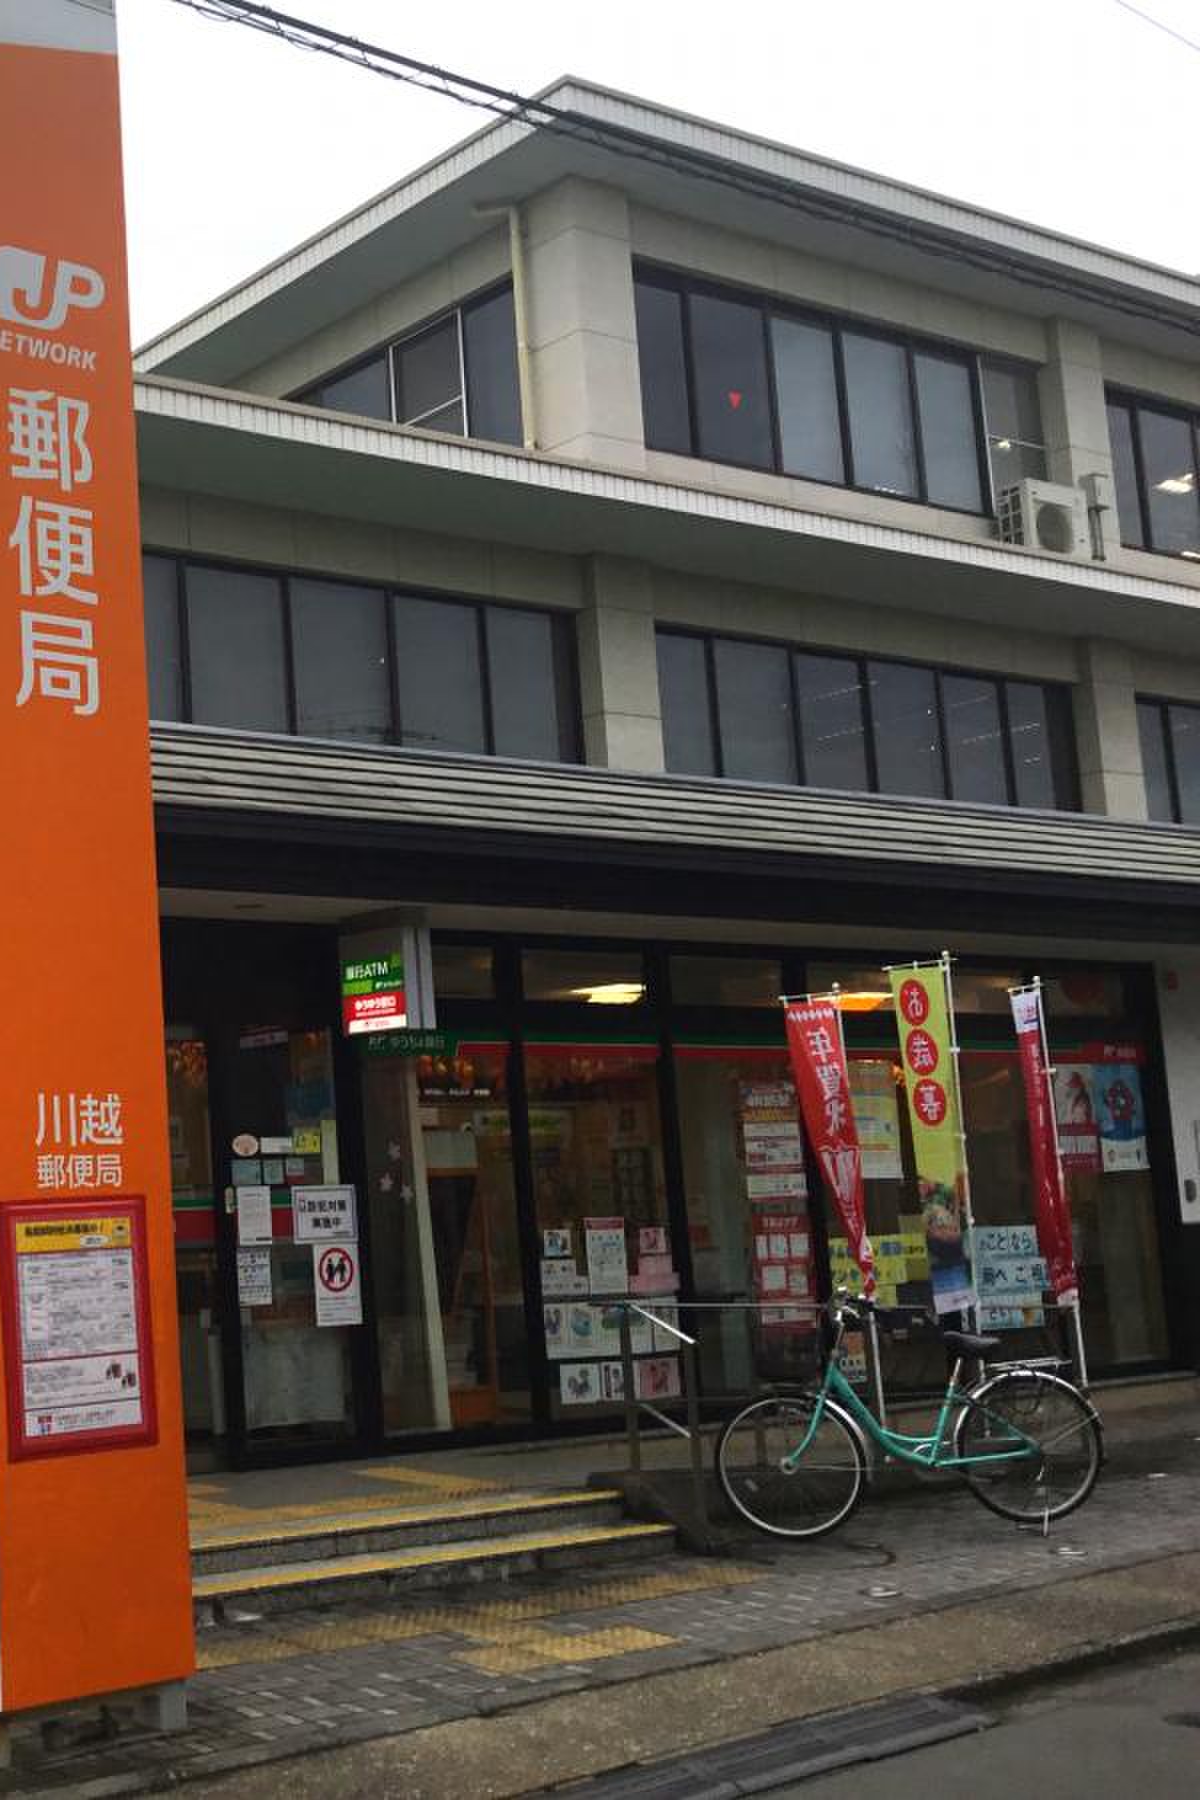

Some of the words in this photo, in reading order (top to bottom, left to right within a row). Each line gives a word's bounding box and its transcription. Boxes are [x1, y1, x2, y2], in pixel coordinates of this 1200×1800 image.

[7, 385, 100, 717] 郵便局
[35, 1092, 123, 1147] 川越
[36, 1153, 122, 1188] 郵便局
